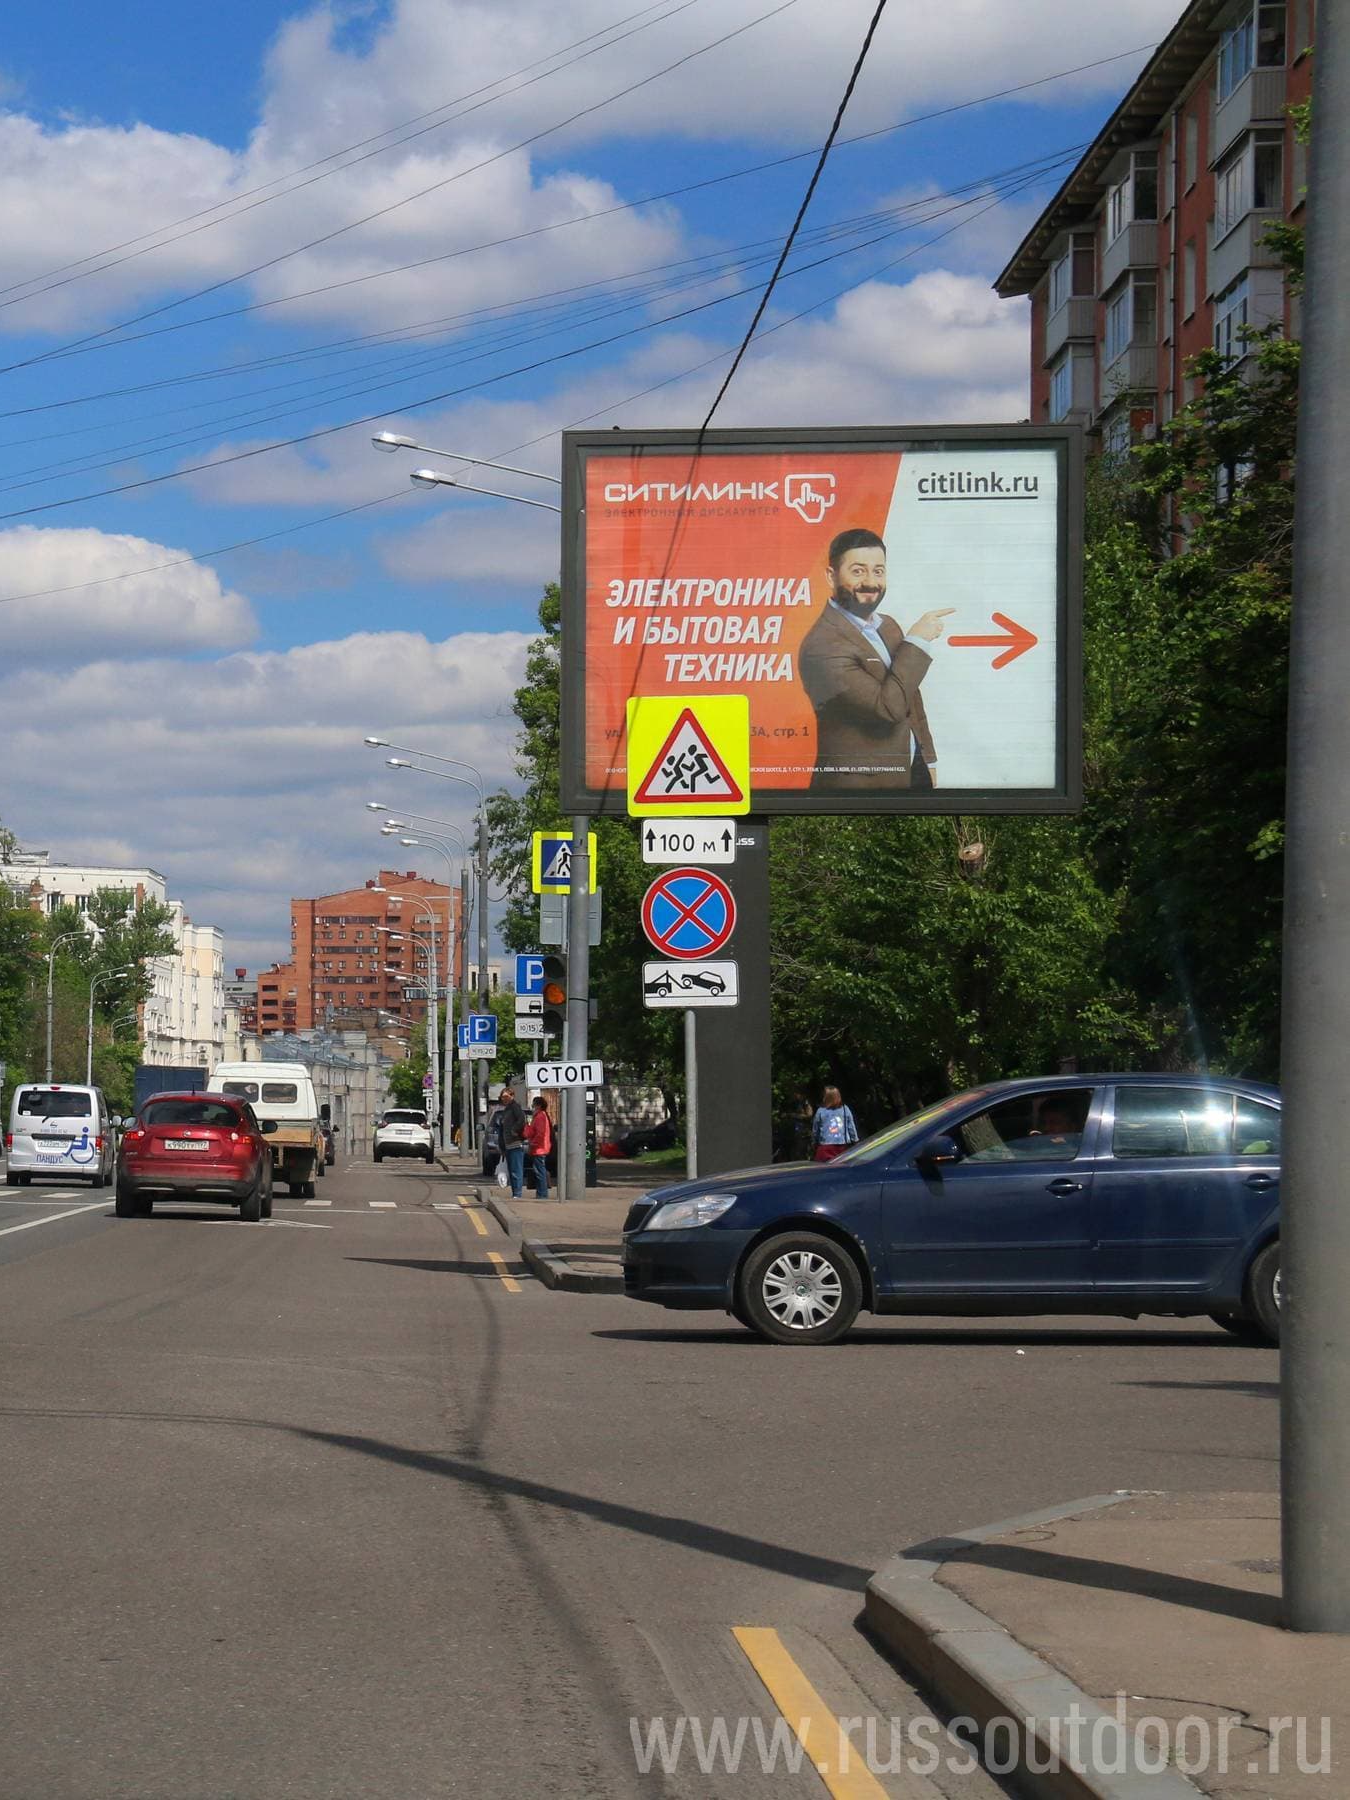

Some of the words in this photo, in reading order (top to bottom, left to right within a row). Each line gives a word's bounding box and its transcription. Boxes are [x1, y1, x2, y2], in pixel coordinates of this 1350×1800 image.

[604, 482, 779, 502] СИТИЛИНК
[917, 471, 1039, 494] citilink.ru
[605, 578, 812, 607] ЭЛЕКТРОНИКА
[613, 617, 636, 644] И
[642, 616, 783, 644] БЫТОВАЯ
[664, 654, 794, 682] ТЕХНИКА
[773, 728, 798, 739] стр.
[802, 726, 810, 737] 1
[659, 834, 695, 852] 100
[475, 1018, 491, 1041] P
[536, 1064, 593, 1084] СТОП
[36, 1154, 64, 1164] ПАНДУС
